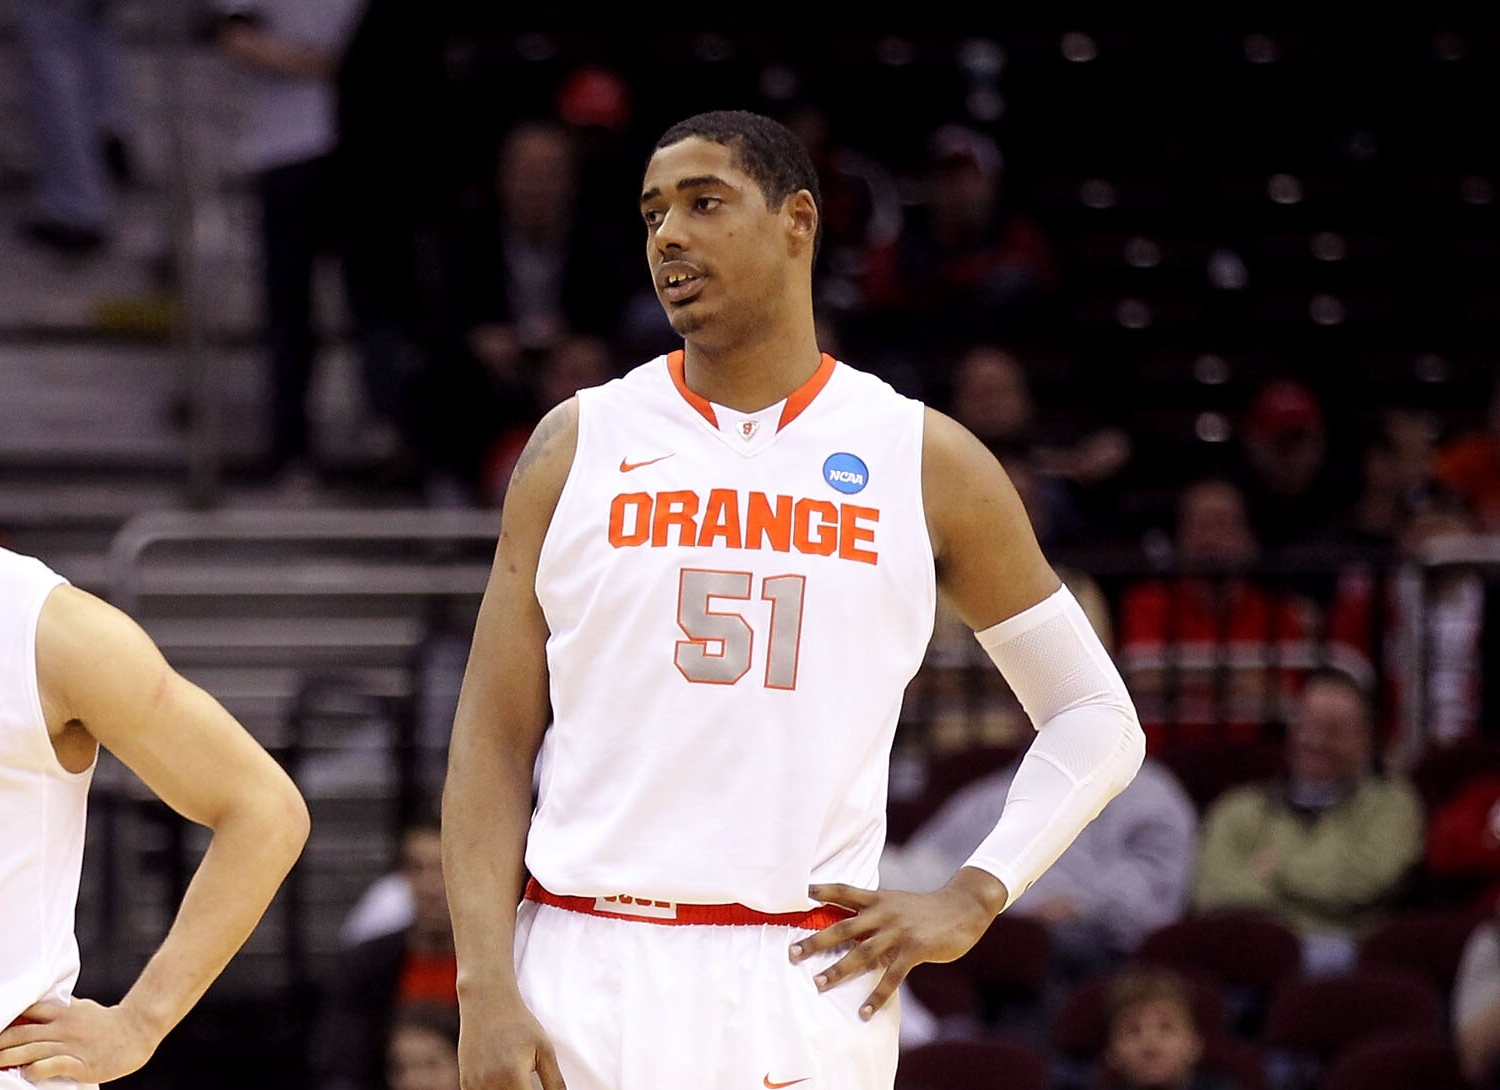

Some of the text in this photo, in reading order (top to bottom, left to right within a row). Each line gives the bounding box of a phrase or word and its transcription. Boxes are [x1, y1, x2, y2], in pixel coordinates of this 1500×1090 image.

[829, 469, 863, 485] NCAA
[608, 488, 880, 566] ORANGE
[674, 568, 806, 691] 51
